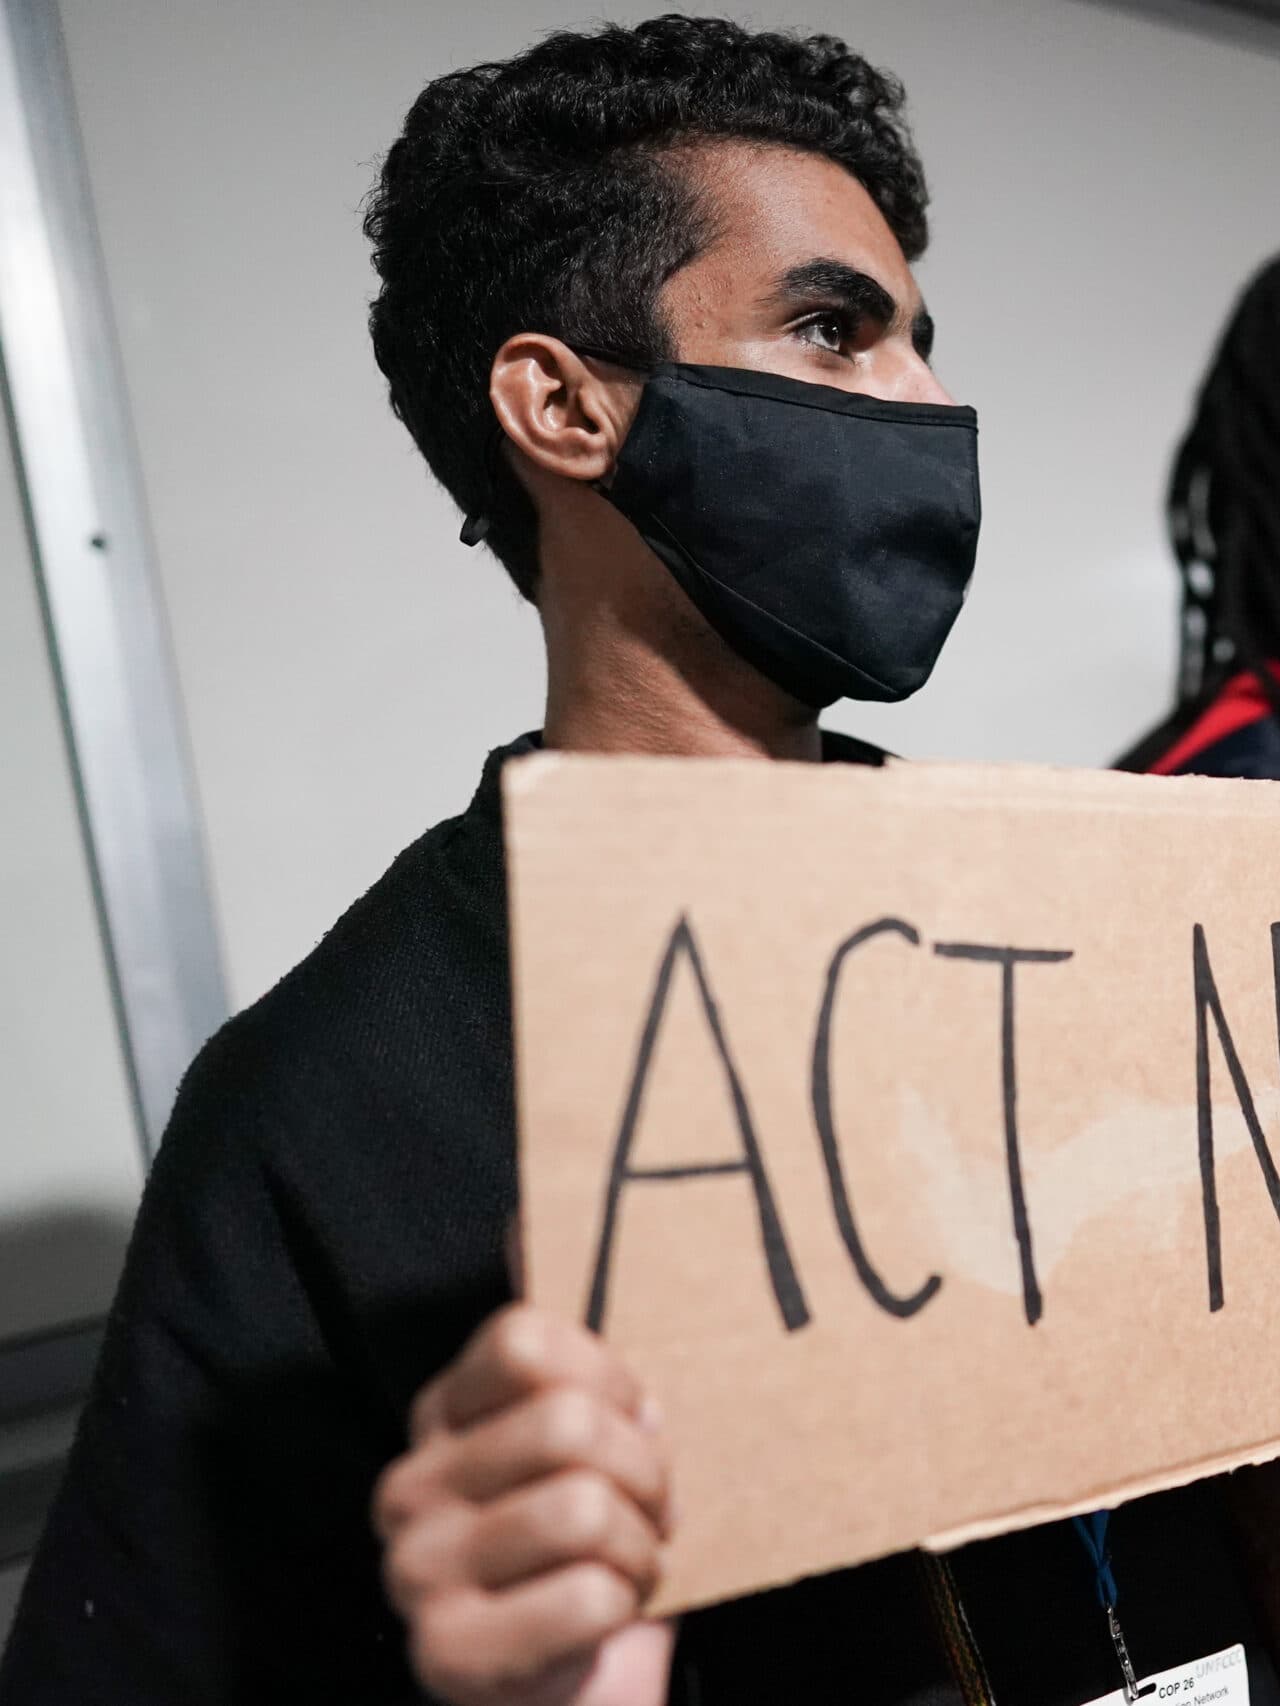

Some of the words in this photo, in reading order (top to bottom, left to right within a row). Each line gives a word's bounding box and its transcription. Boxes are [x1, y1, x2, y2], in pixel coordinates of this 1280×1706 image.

[586, 910, 1074, 1333] ACT
[1159, 1682, 1180, 1699] COP
[1183, 1677, 1195, 1690] 26
[1194, 1686, 1229, 1705] Network
